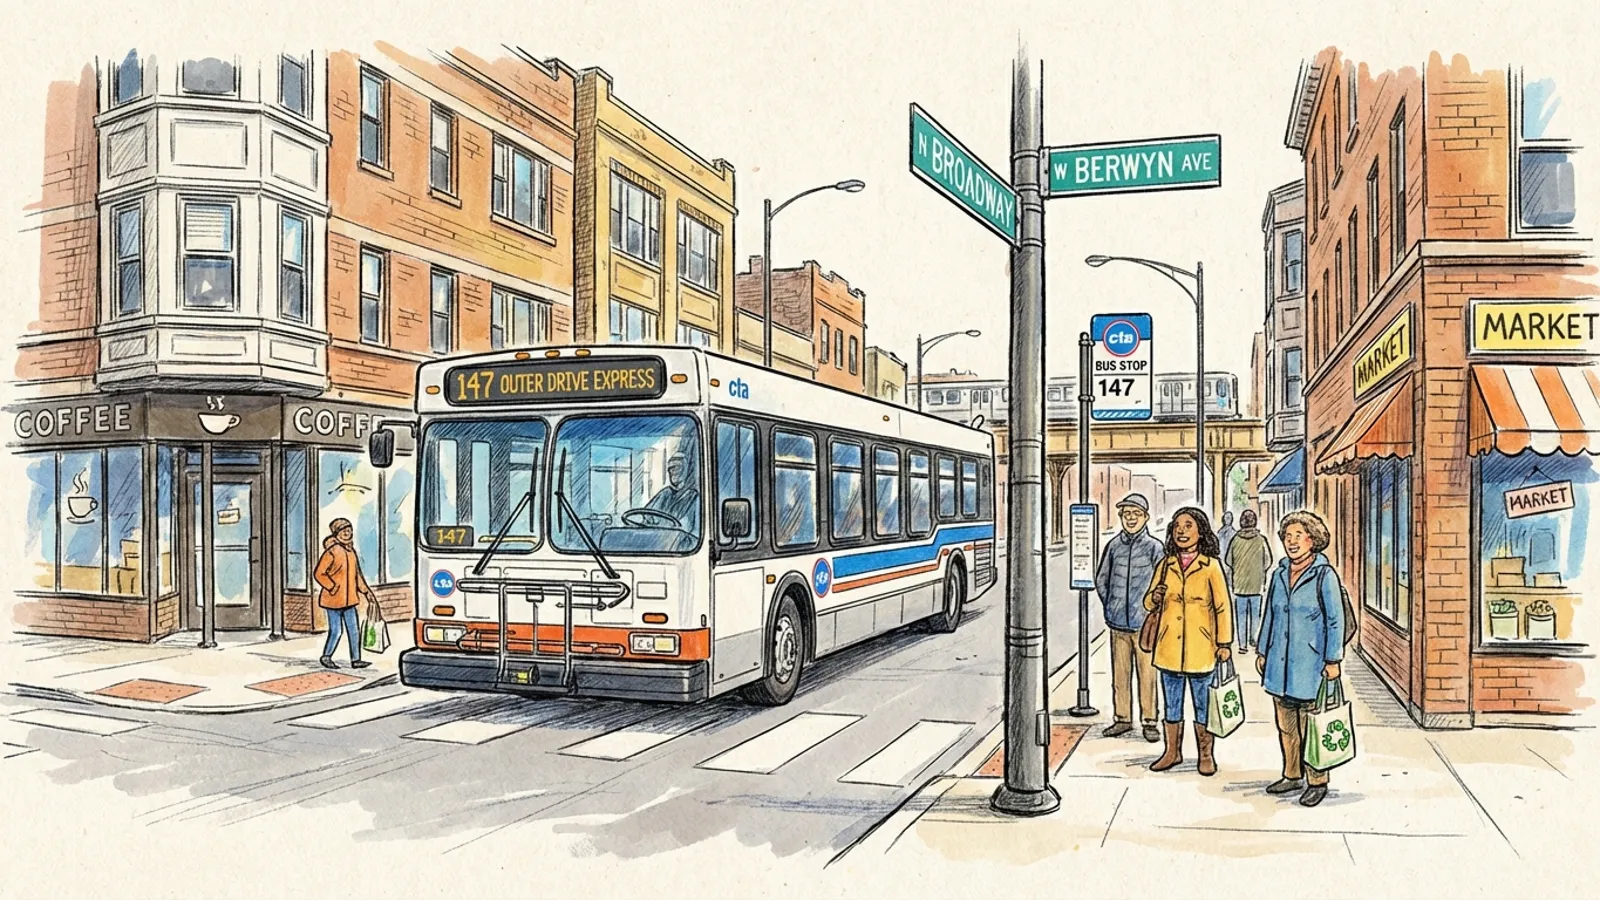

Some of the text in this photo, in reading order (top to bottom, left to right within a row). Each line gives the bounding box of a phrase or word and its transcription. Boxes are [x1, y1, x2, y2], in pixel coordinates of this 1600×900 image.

[918, 131, 1018, 228] N BROADWAY
[1054, 151, 1212, 184] W BERWYN AVE
[1482, 312, 1600, 341] MARKET
[1095, 360, 1148, 371] BUS STOP
[1357, 323, 1406, 389] MARKET
[457, 367, 655, 401] 147 OUTER DRIVE EXPRESS
[728, 377, 749, 400] cta
[1098, 378, 1136, 397] 147
[14, 402, 132, 439] COFFEE
[436, 528, 467, 545] 147
